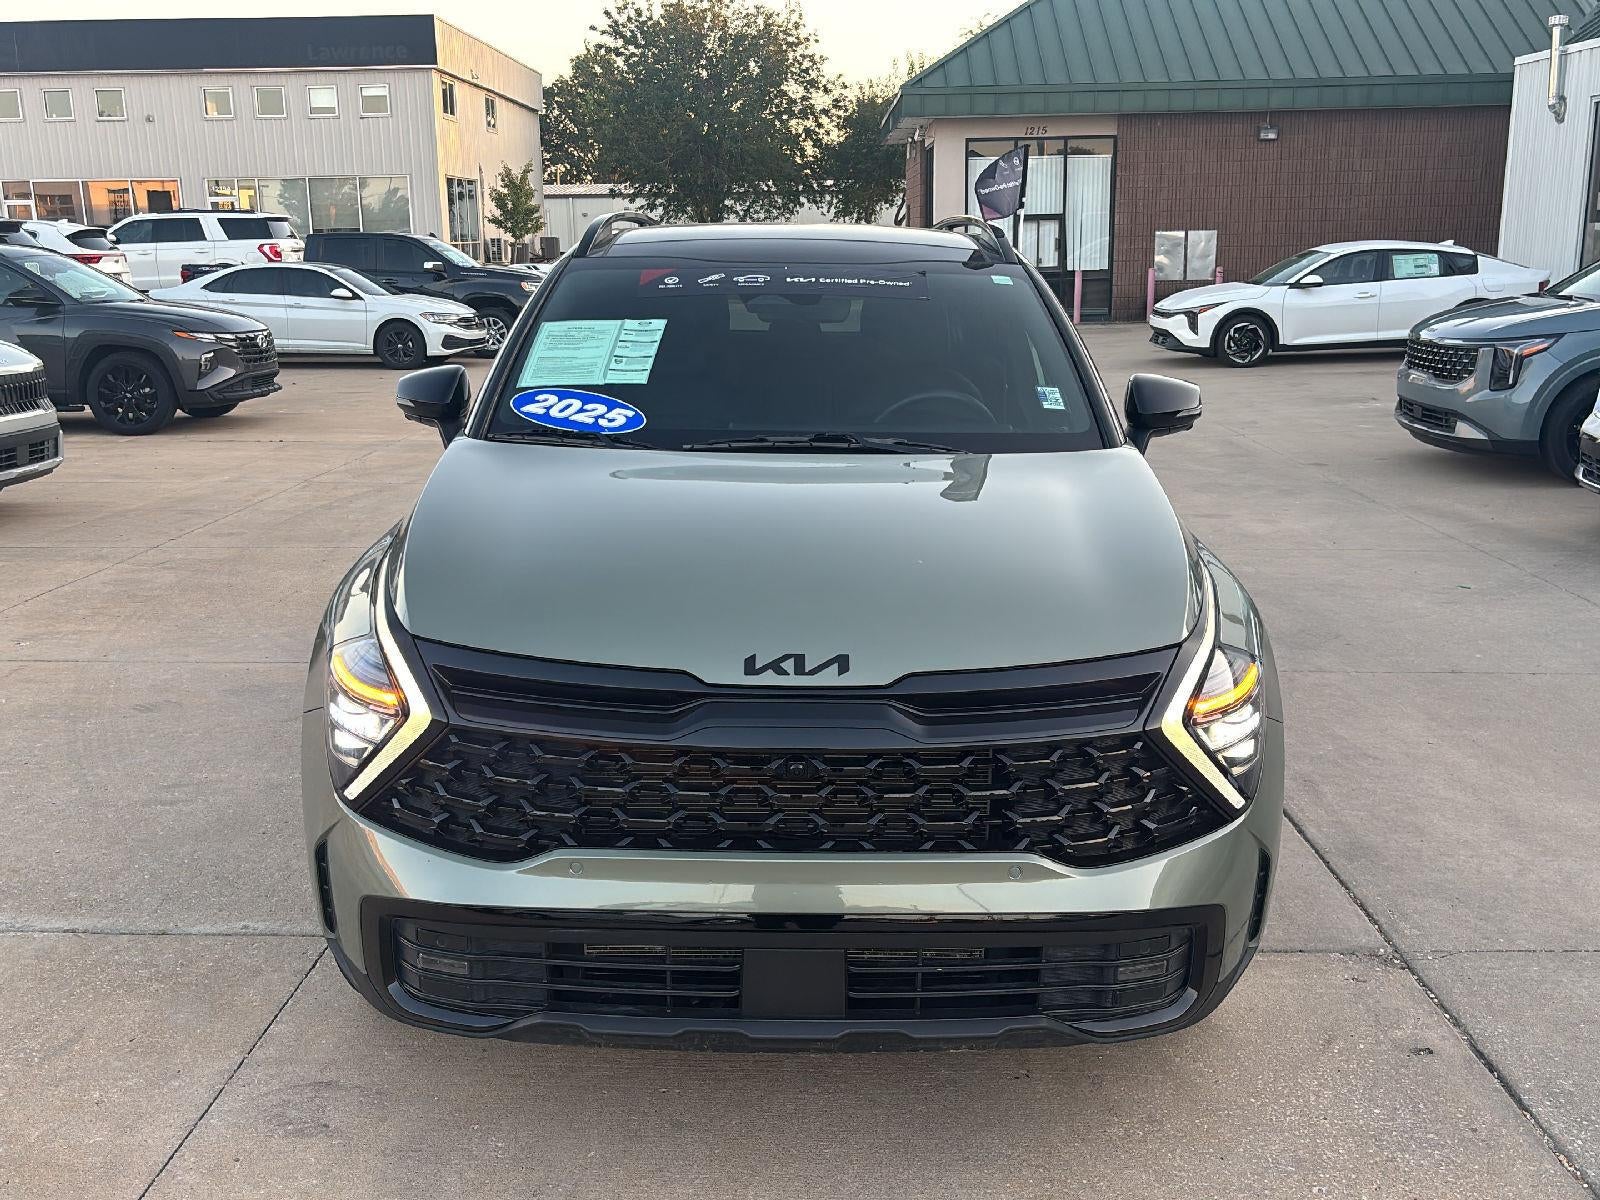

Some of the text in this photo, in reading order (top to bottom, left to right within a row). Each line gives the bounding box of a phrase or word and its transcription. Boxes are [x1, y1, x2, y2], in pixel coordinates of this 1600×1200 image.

[307, 43, 408, 60] Lawrence
[1024, 126, 1048, 136] 1215
[860, 278, 911, 287] Pre-Owned
[520, 393, 636, 428] 2025
[743, 653, 850, 677] KIA
